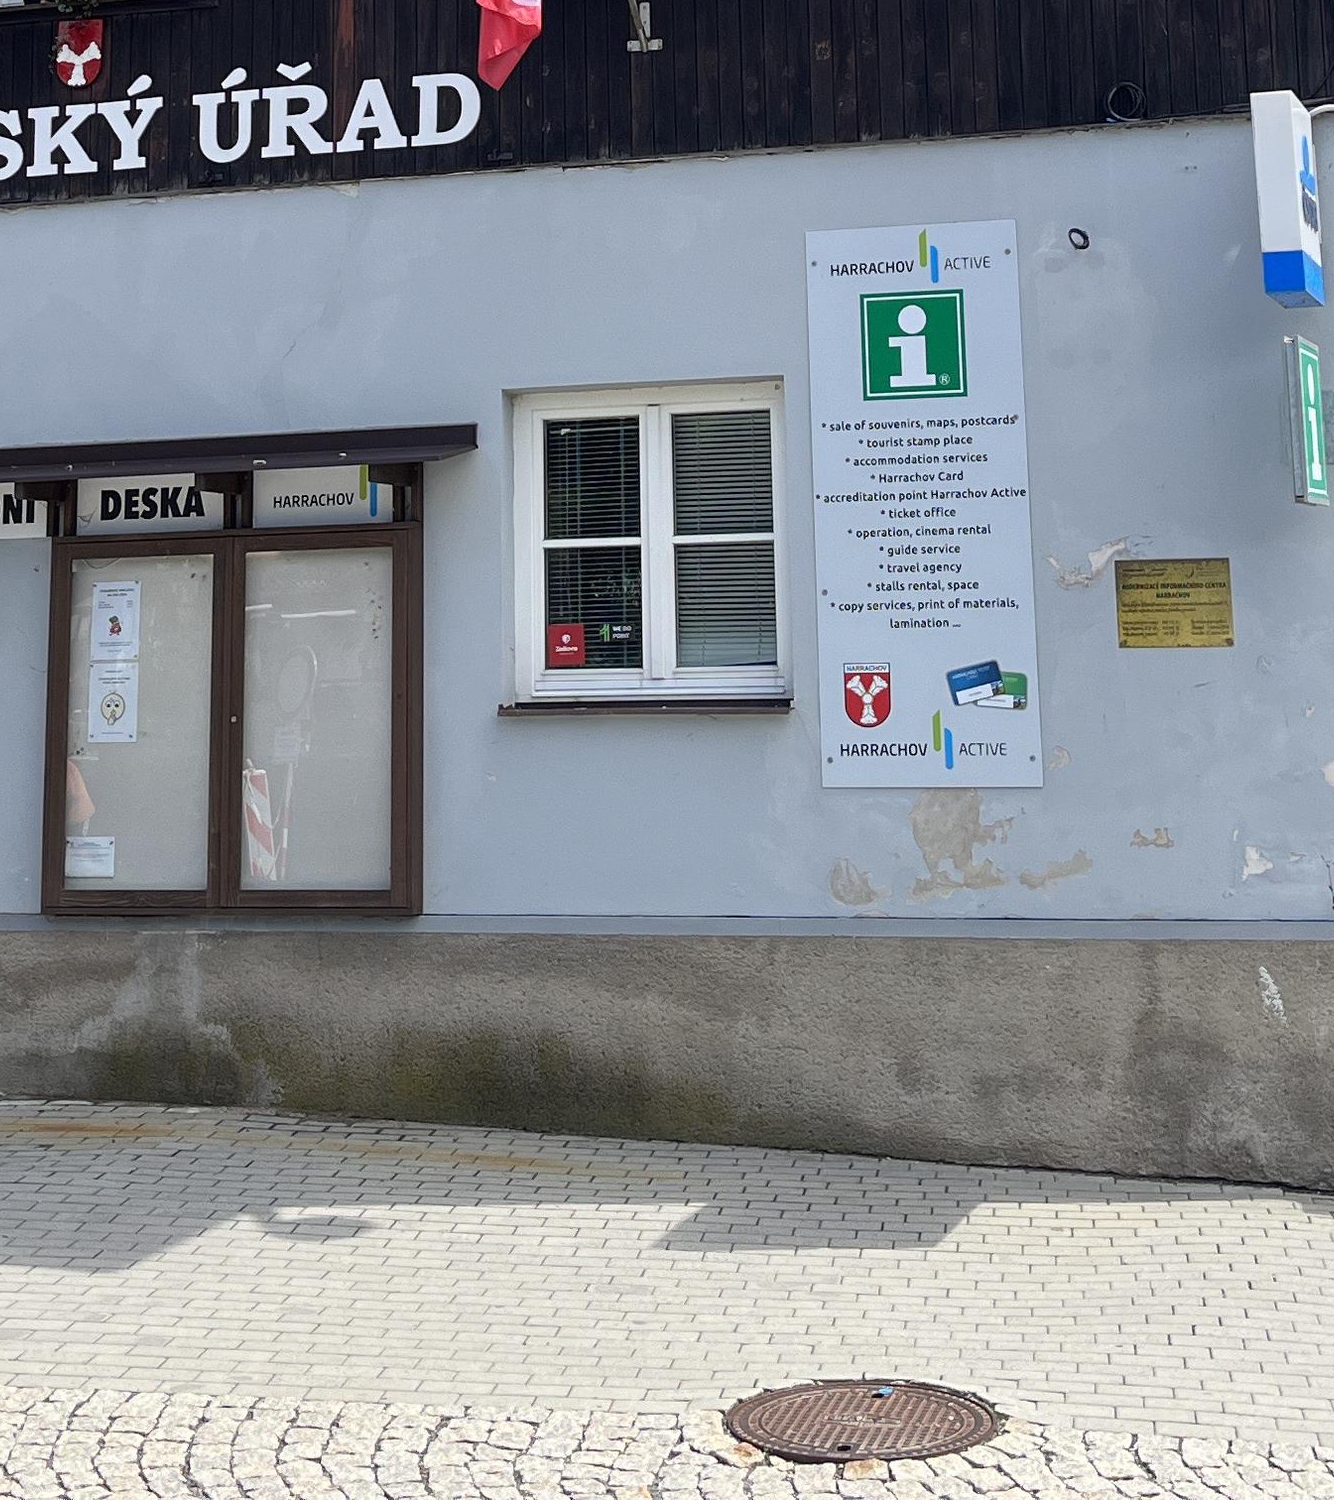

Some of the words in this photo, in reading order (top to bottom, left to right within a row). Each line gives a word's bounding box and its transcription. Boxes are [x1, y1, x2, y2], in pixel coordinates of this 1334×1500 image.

[192, 62, 483, 164] ÚŘAD
[830, 260, 914, 276] HARRACHOV
[944, 255, 991, 271] ACTIVE
[829, 421, 851, 432] sale
[854, 420, 866, 431] of
[868, 418, 924, 430] souvenirs,
[926, 419, 958, 429] maps,
[961, 415, 1016, 428] postcards
[867, 437, 904, 448] tourist
[907, 437, 940, 447] stamp
[943, 434, 973, 447] place
[853, 453, 939, 466] accommodation
[943, 452, 988, 463] services
[879, 472, 935, 483] Harrachov
[938, 470, 964, 481] Card
[273, 492, 354, 509] HARRACHOV
[823, 491, 896, 503] accreditation
[899, 490, 928, 503] point
[931, 488, 988, 499] Harrachov
[990, 487, 1026, 498] Active
[100, 485, 206, 523] DESKA
[889, 508, 921, 519] ticket
[924, 507, 956, 517] office
[856, 527, 913, 540] operation,
[915, 526, 954, 536] cinema
[957, 524, 991, 535] rental
[887, 544, 918, 557] guide
[921, 543, 961, 555] service
[887, 562, 920, 573] travel
[922, 564, 962, 574] agency
[876, 580, 905, 592] stalls
[908, 580, 945, 592] rental,
[947, 581, 979, 592] space
[838, 603, 864, 613] copy
[867, 600, 915, 612] services,
[918, 599, 945, 612] print
[948, 598, 960, 609] of
[963, 597, 1019, 609] materials,
[890, 617, 949, 629] lamination
[840, 743, 928, 757] HARRACHOV
[959, 742, 1007, 756] ACTIVE
